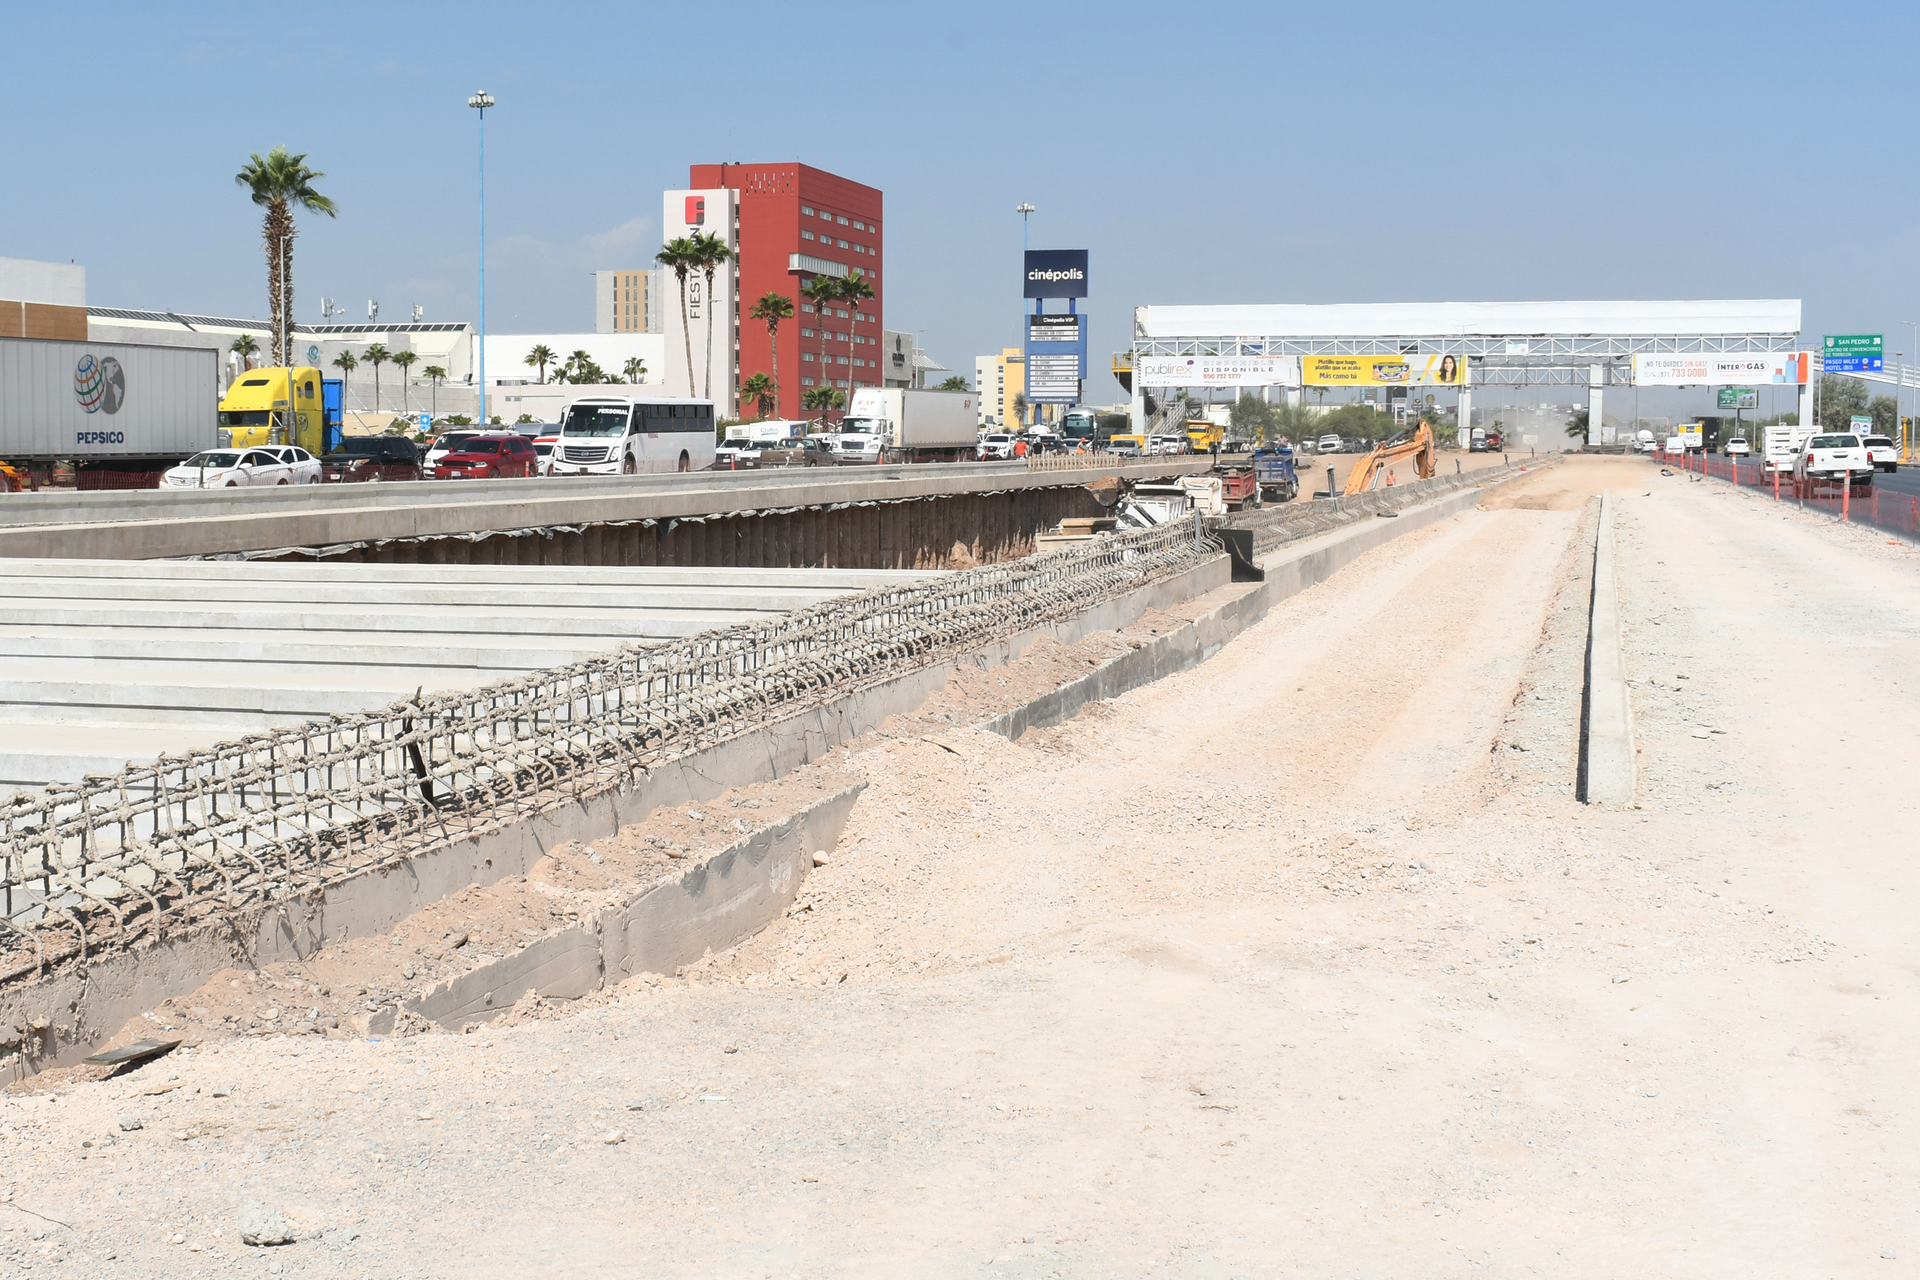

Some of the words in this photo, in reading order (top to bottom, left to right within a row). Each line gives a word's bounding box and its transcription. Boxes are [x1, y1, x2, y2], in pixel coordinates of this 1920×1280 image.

[1028, 268, 1084, 282] cinépolis
[1145, 363, 1192, 377] publirex
[1671, 368, 1685, 378] 733
[1687, 368, 1707, 378] 0000
[597, 408, 629, 416] PERSONAL
[77, 431, 124, 444] PEPSICO
